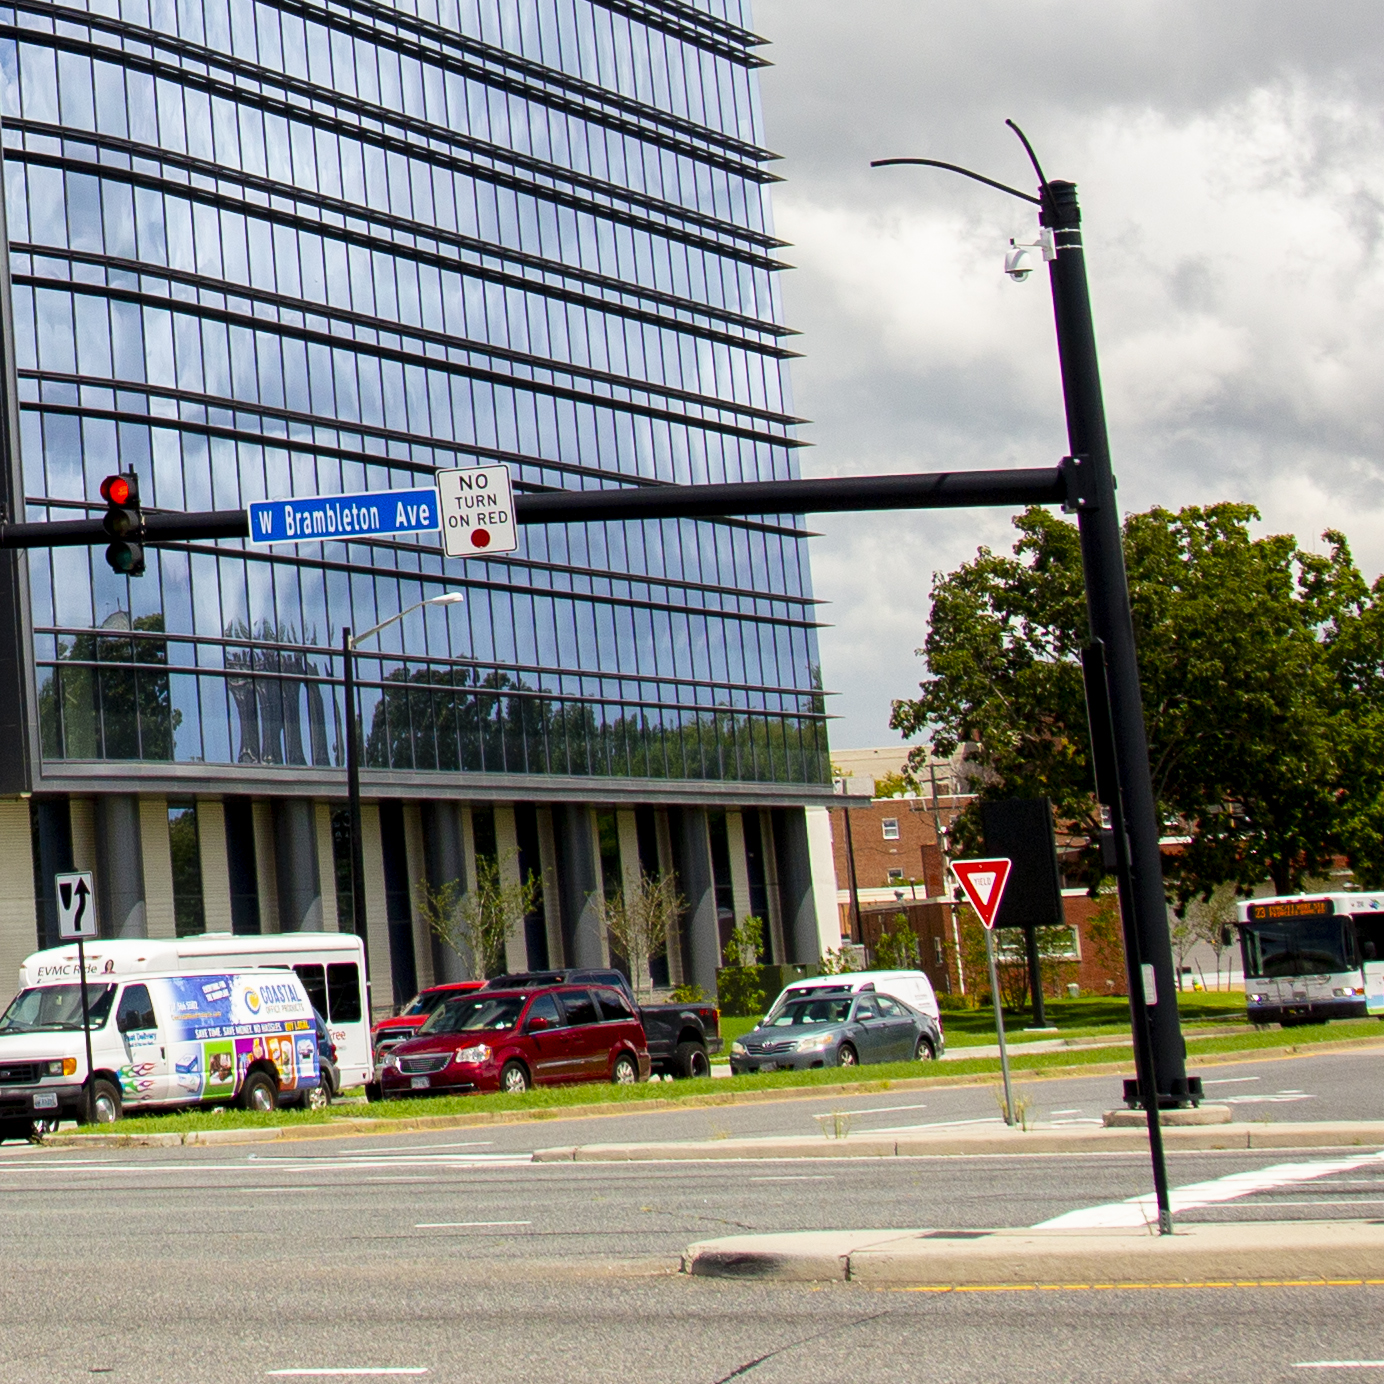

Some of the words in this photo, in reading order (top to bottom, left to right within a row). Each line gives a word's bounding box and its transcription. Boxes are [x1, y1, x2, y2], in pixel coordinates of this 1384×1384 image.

[459, 473, 489, 491] NO
[454, 494, 498, 510] TURN
[258, 510, 273, 535] W
[284, 502, 381, 537] Brambleton
[394, 501, 431, 529] Ave
[448, 515, 471, 529] ON
[476, 511, 509, 526] RED
[974, 877, 992, 886] YIELD
[37, 964, 71, 977] EVMC
[73, 963, 98, 975] Rde
[259, 983, 303, 1005] COASTAL
